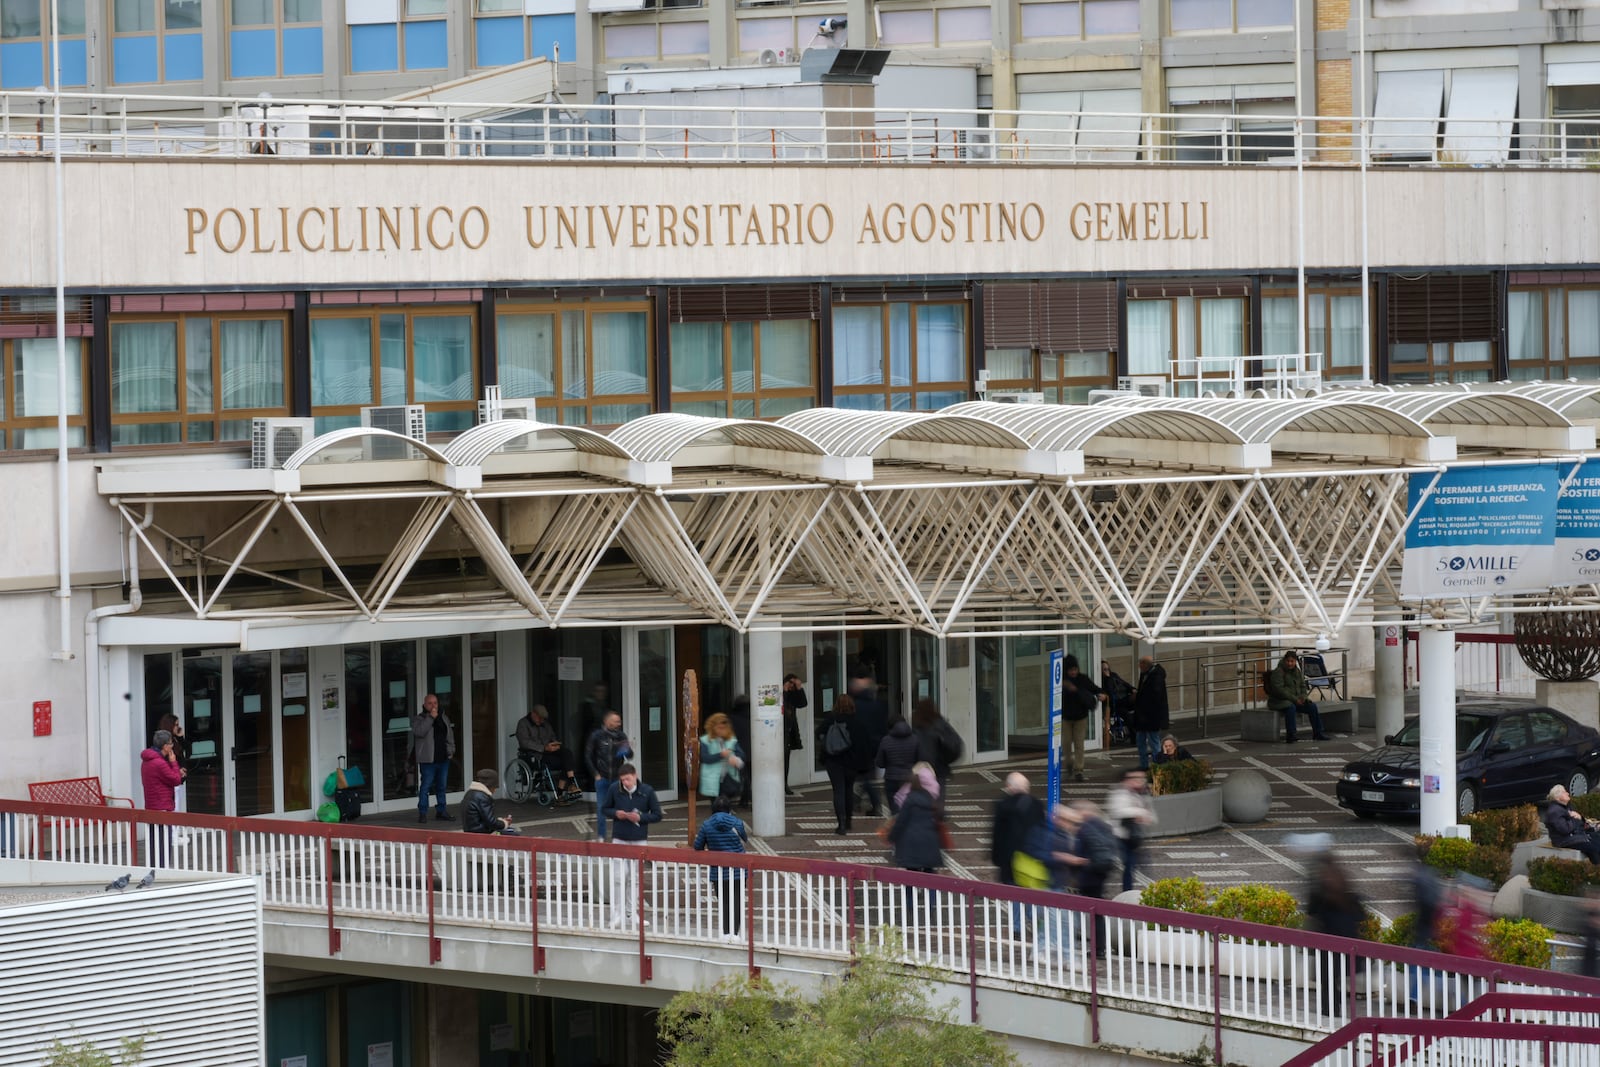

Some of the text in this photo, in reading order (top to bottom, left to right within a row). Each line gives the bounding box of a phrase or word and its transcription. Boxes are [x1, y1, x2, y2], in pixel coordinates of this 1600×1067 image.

[184, 201, 1210, 255] POLICLINICO UNIVERSITARIO AGOSTINO GEMELLI
[1442, 485, 1482, 494] FERMARE
[1484, 485, 1496, 493] LA
[1497, 483, 1545, 492] SPERANZA,
[1562, 489, 1600, 497] SOSTIE
[1434, 496, 1474, 505] SOSTIENI
[1489, 494, 1528, 503] RICERCA.
[1442, 575, 1486, 587] Gemelli
